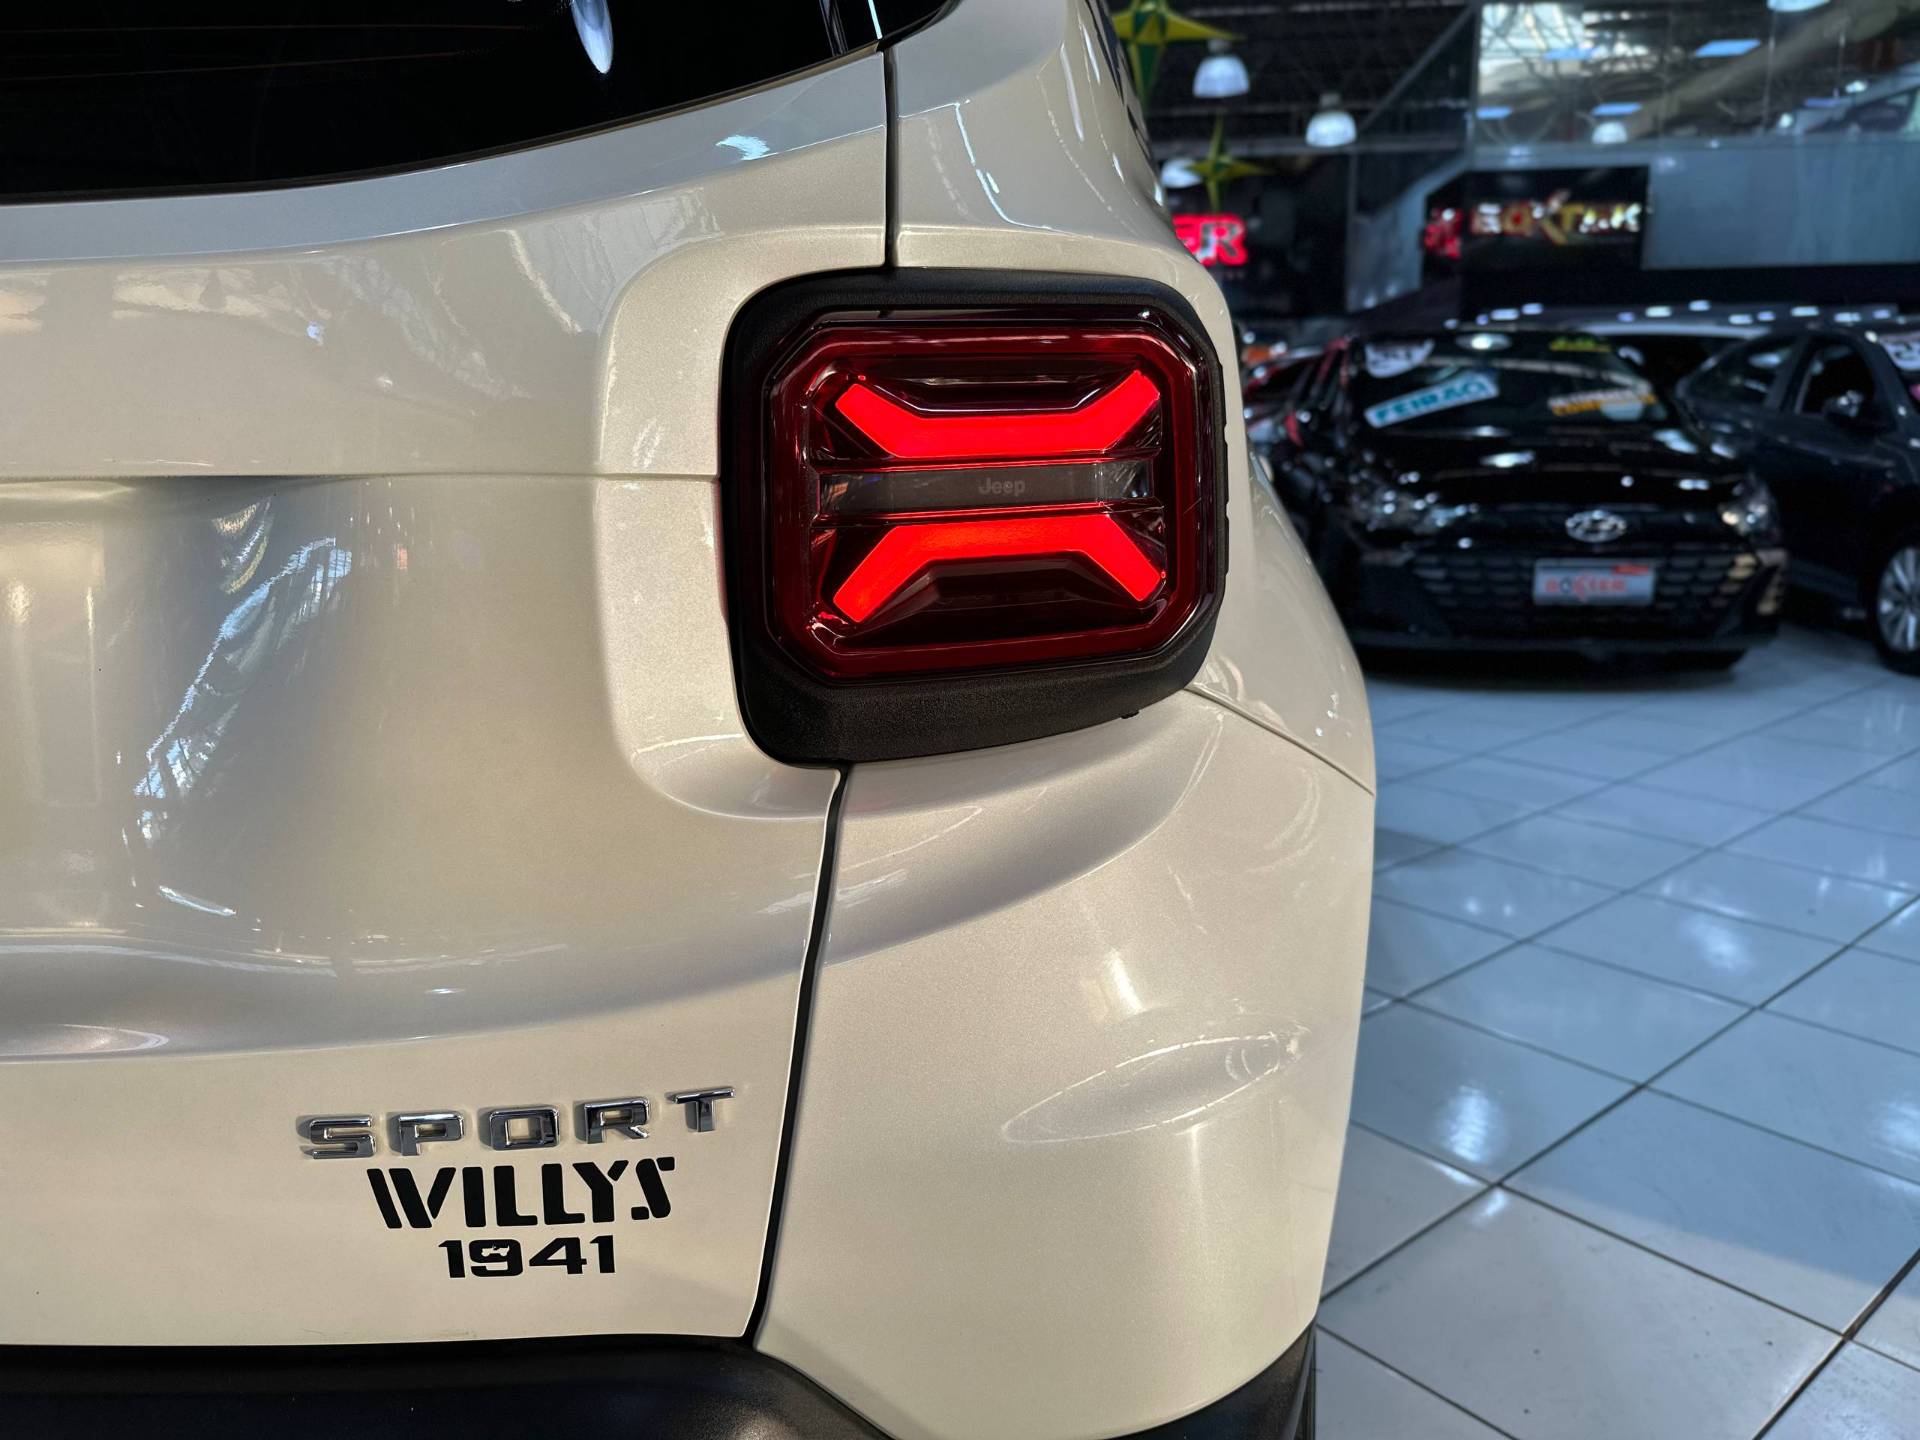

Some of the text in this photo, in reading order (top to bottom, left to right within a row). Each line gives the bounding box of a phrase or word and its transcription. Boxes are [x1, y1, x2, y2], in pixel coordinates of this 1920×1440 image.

[979, 477, 1026, 497] Jeep
[298, 1086, 736, 1161] SPORT
[366, 1156, 676, 1229] WILLYS
[438, 1234, 616, 1279] 1941
